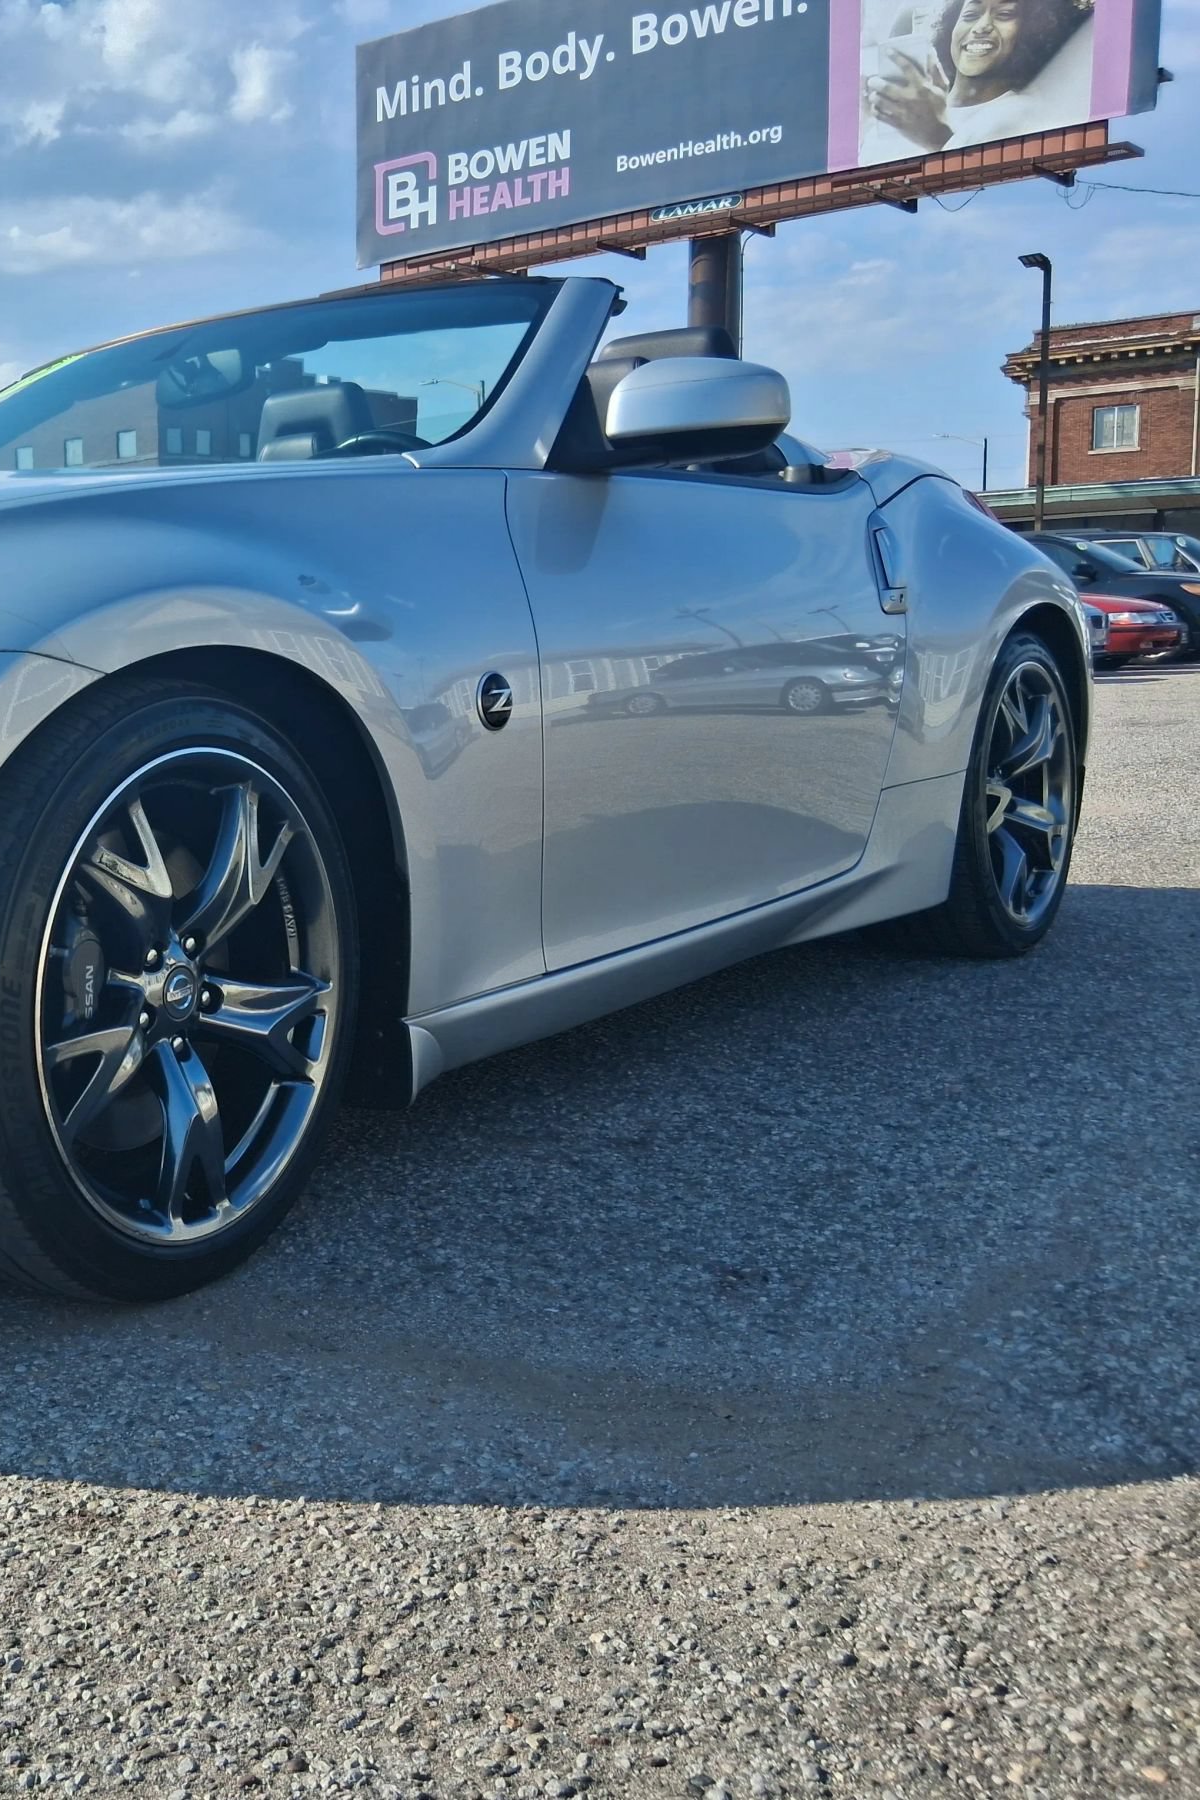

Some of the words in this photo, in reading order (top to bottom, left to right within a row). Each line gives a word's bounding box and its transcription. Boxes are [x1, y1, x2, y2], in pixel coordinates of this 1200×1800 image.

[376, 61, 483, 122] Mind.
[498, 31, 615, 90] Body.
[447, 129, 571, 186] BOWEN
[616, 125, 783, 173] BowenHealth.org
[448, 167, 570, 221] HEALTH
[658, 197, 734, 220] LAMAR
[487, 688, 512, 713] Z
